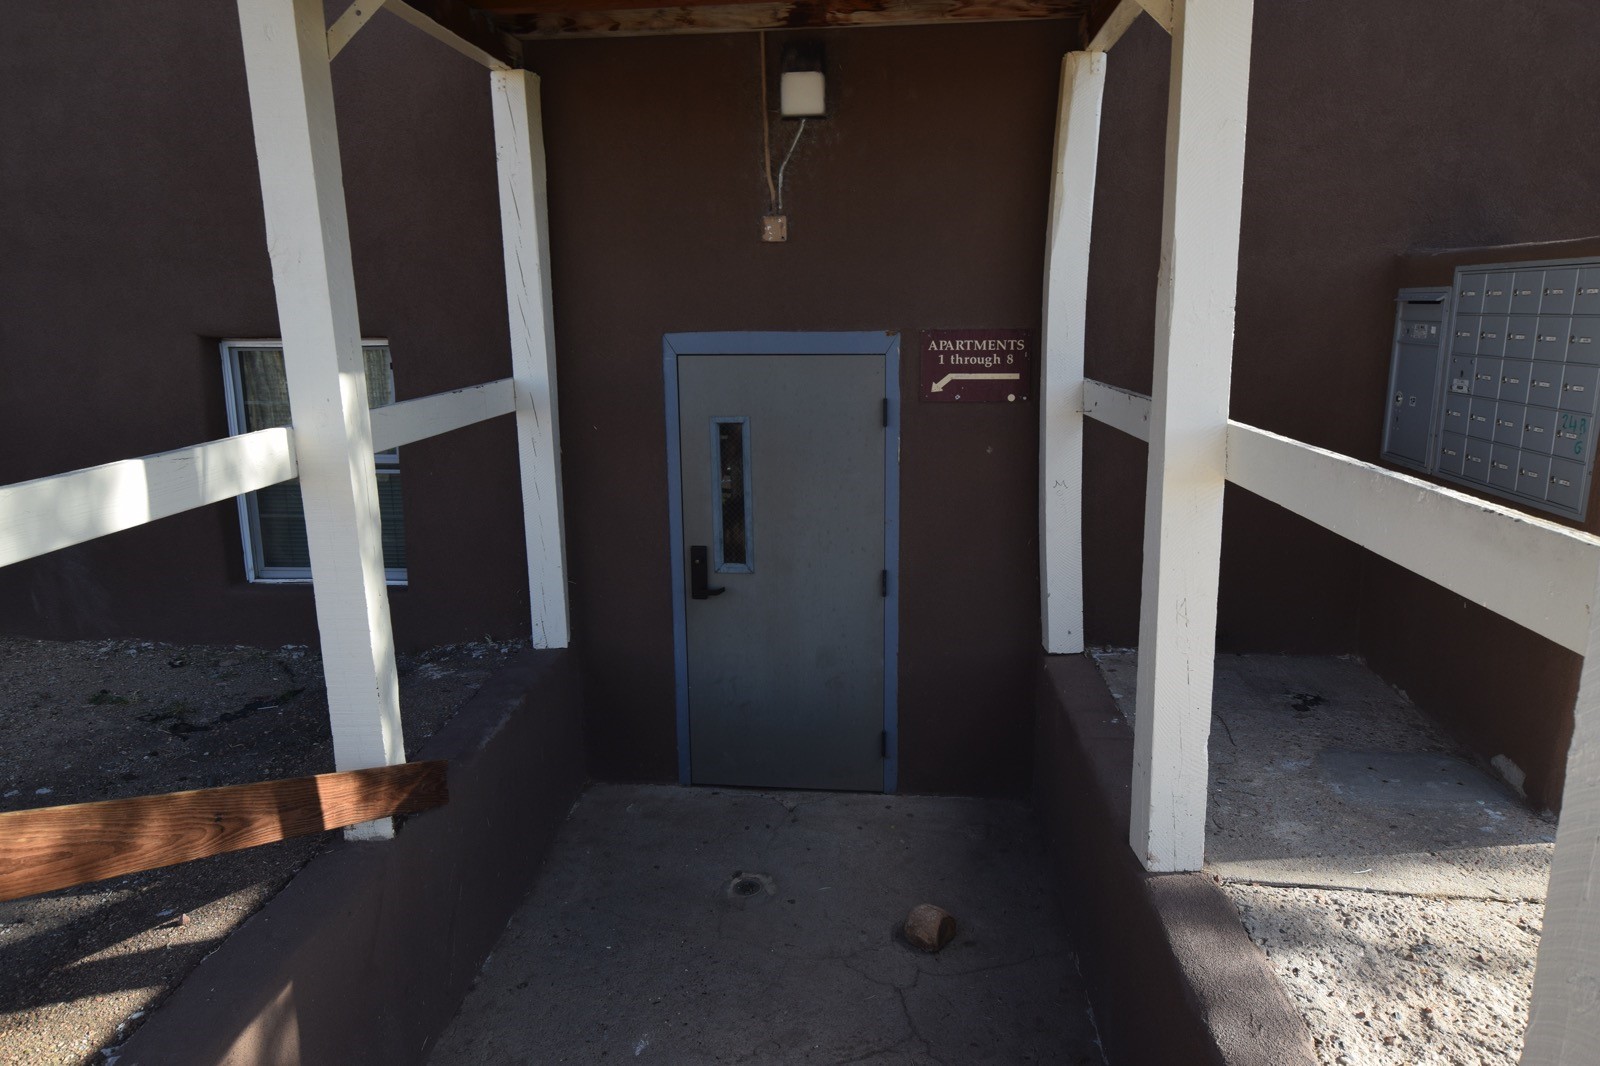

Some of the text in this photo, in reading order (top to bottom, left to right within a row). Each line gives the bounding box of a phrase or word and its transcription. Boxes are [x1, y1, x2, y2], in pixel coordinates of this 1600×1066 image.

[928, 339, 1025, 351] APARTMENTS
[938, 353, 1014, 368] 1 through 8
